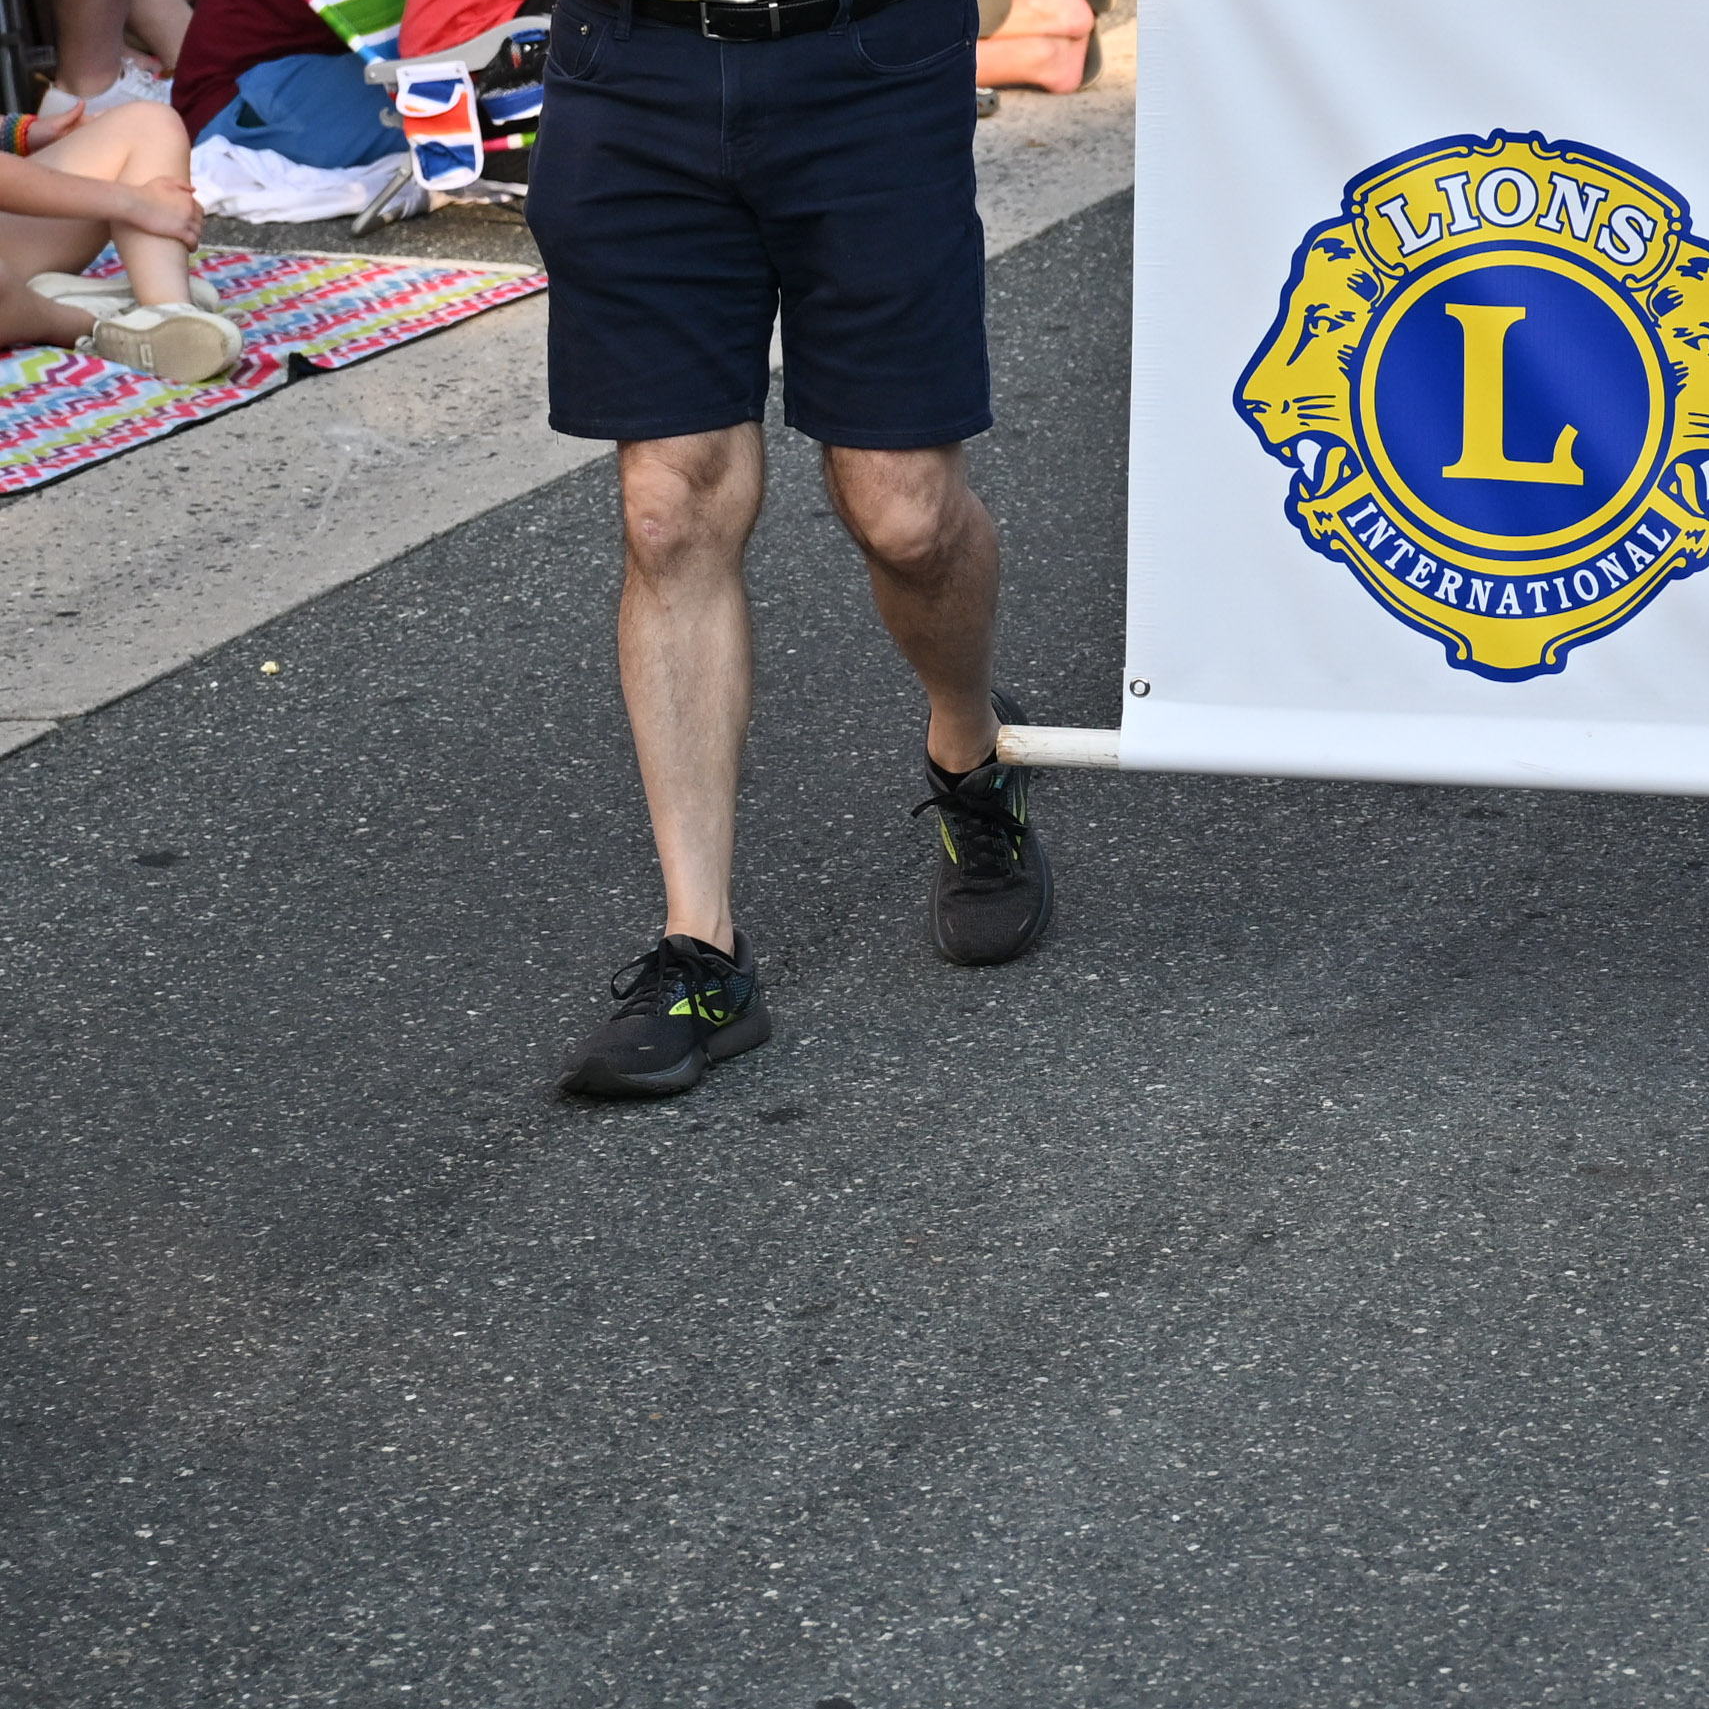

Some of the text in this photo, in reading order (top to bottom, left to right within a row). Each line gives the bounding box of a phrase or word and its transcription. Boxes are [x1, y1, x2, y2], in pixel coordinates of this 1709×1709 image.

[1378, 167, 1657, 266] LIONS
[1442, 302, 1585, 486] L
[1346, 500, 1672, 616] INTERNATIONAL
